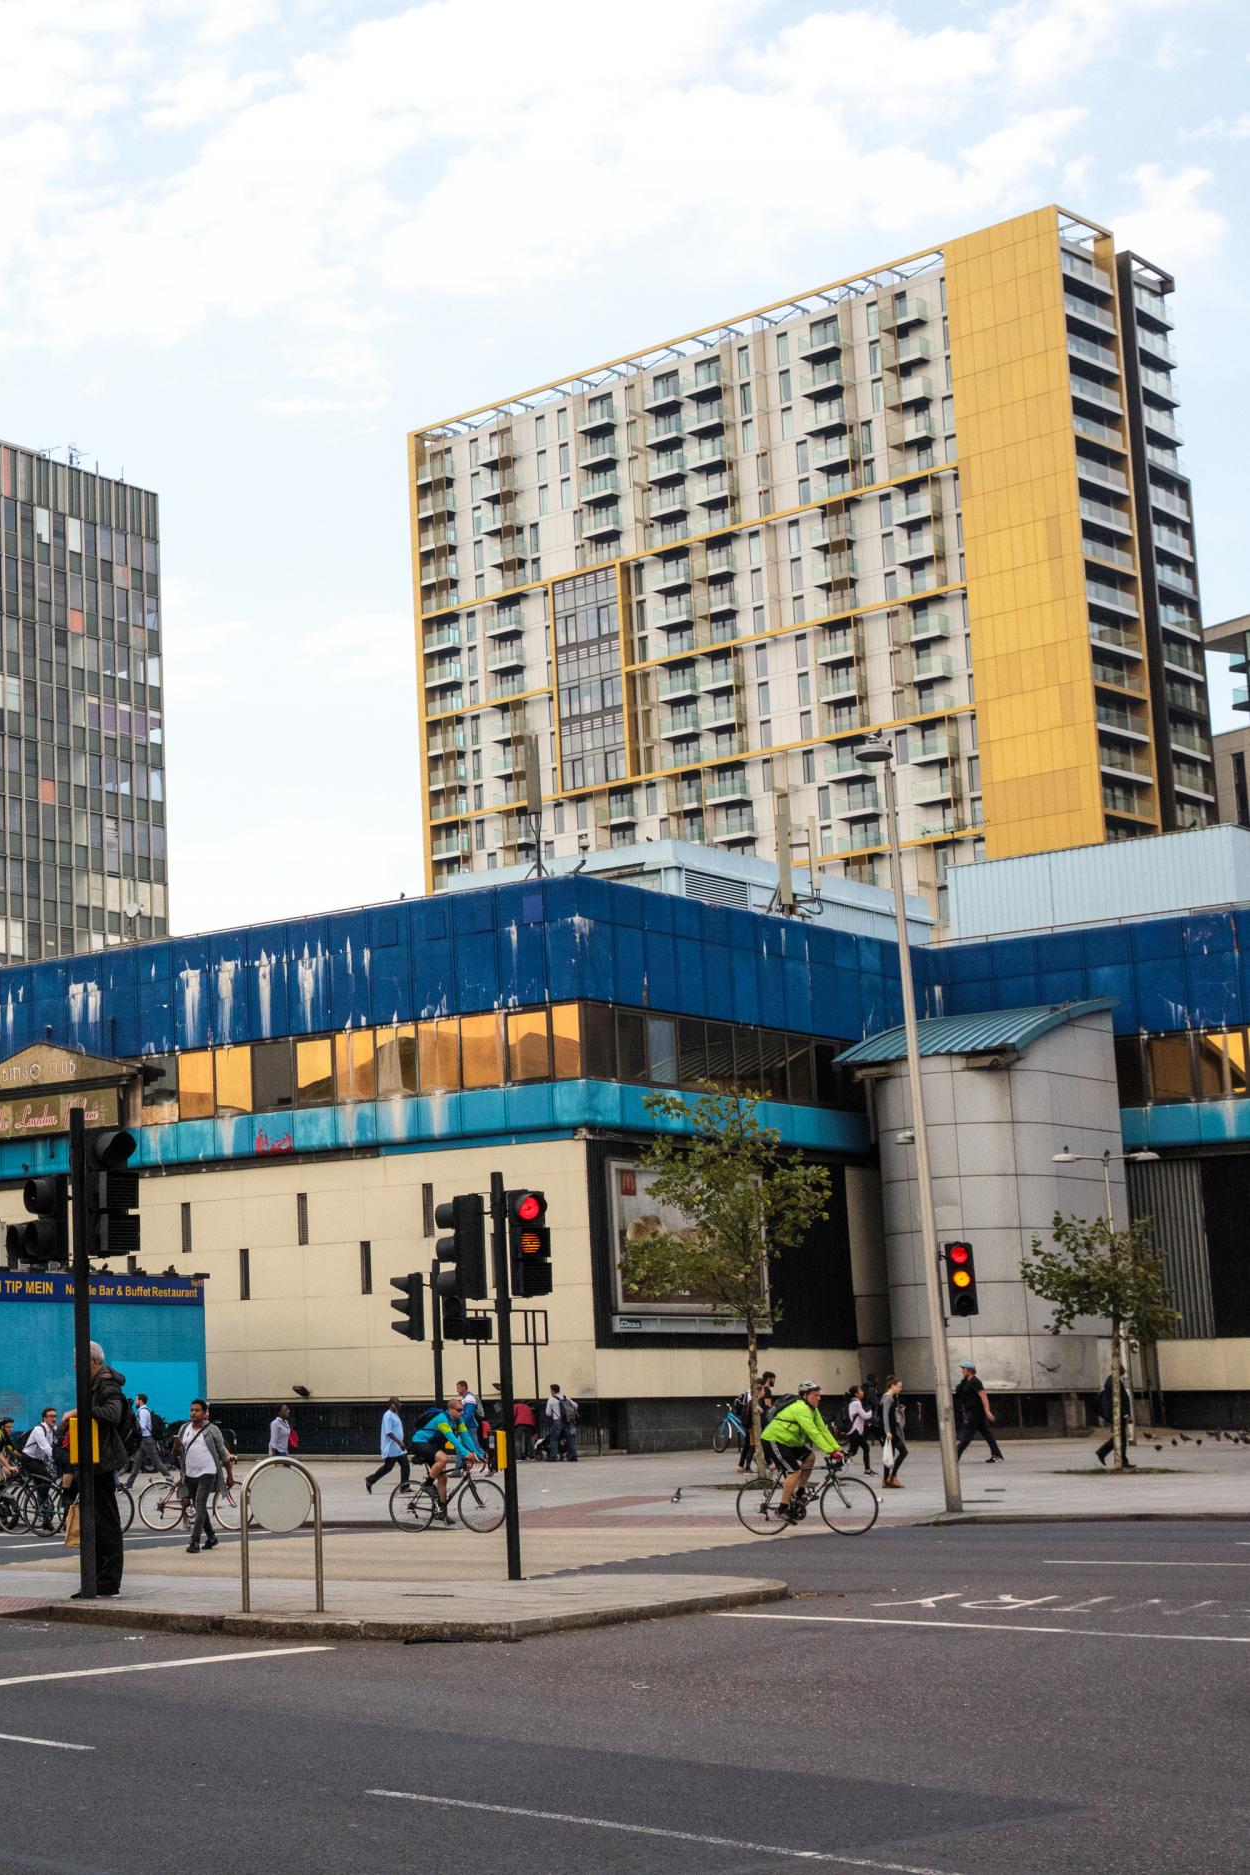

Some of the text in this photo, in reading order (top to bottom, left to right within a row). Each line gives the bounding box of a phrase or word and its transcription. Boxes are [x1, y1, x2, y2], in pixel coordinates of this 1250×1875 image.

[2, 1059, 76, 1082] BINGO CLUB
[14, 1104, 57, 1129] London
[64, 1096, 100, 1128] Place
[5, 1280, 23, 1294] TIP
[25, 1281, 54, 1295] MEIN
[65, 1284, 198, 1298] Nle Bar & Buffet Restaurant
